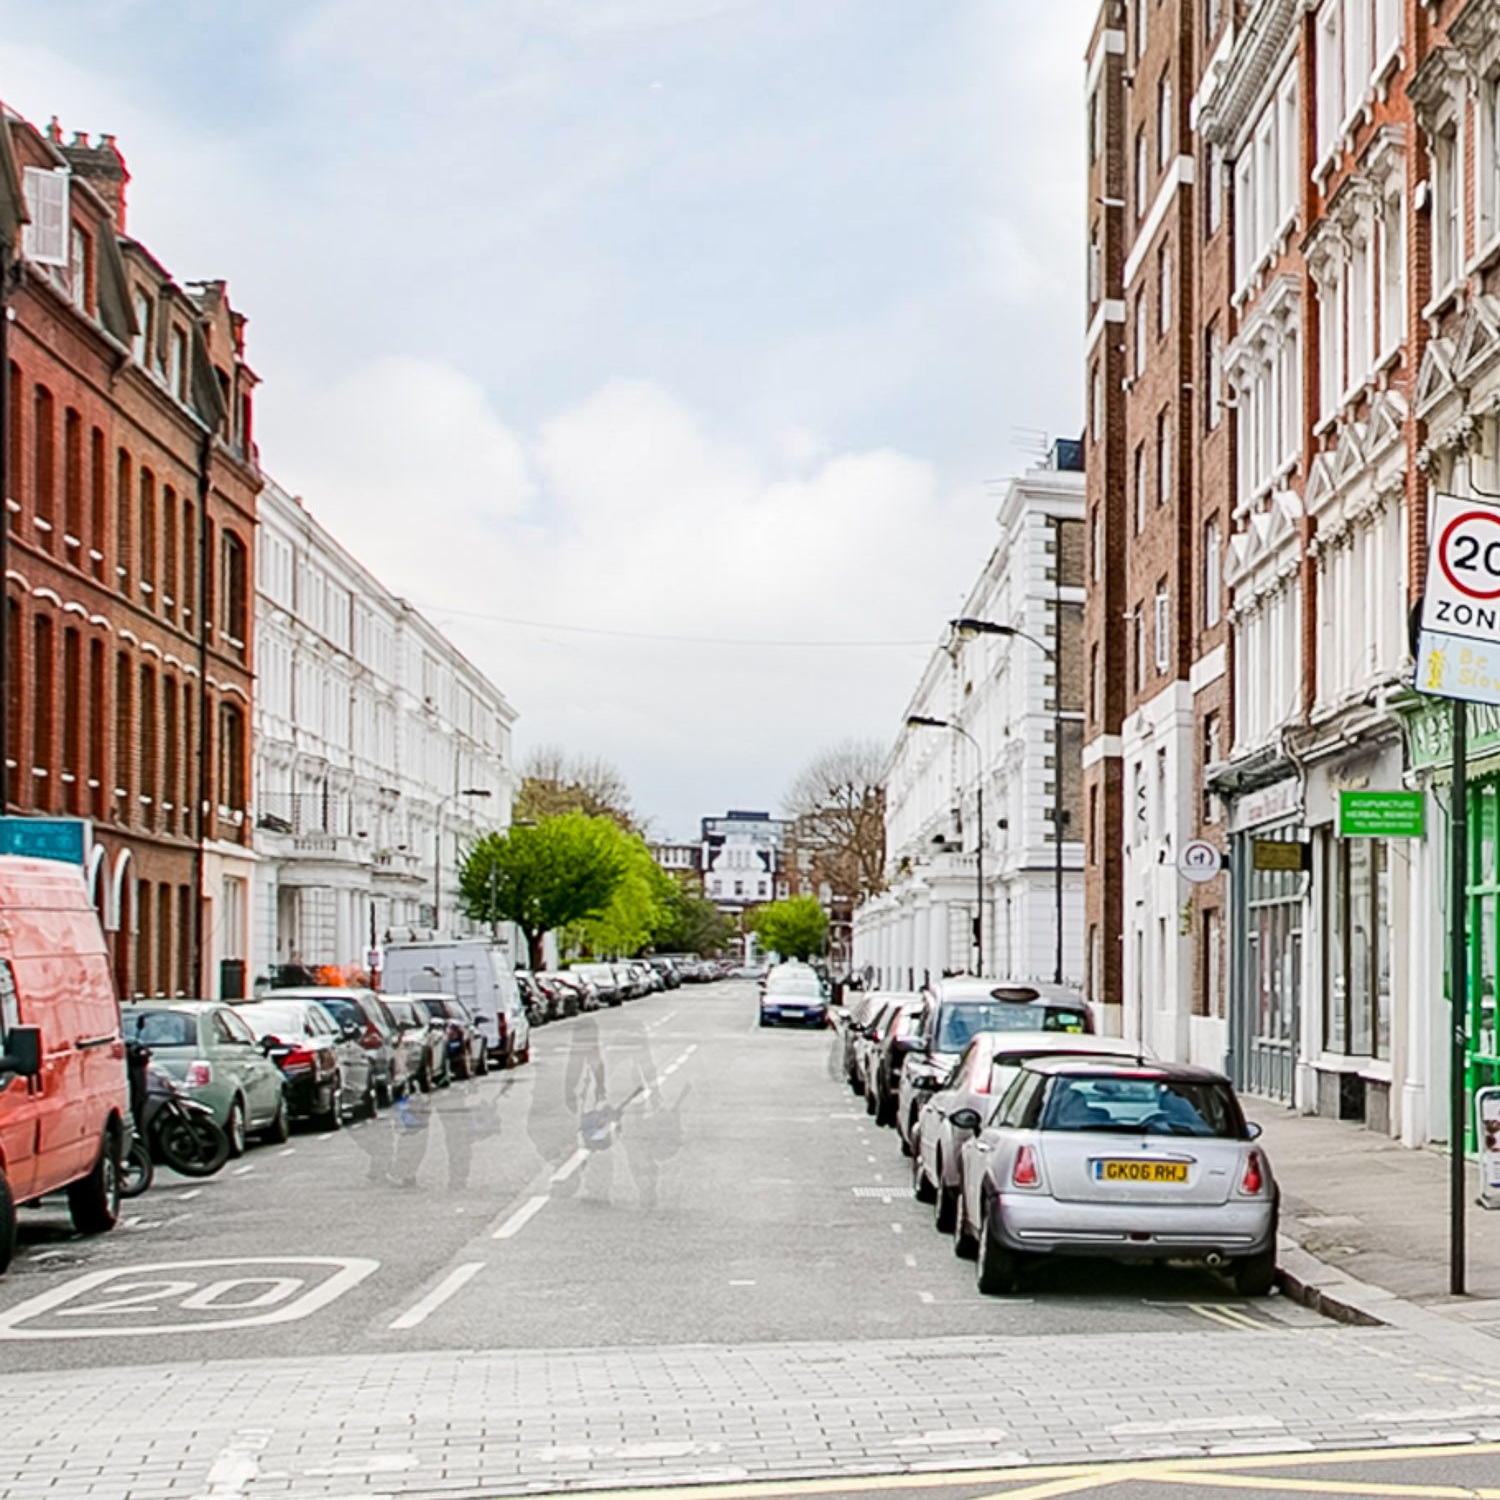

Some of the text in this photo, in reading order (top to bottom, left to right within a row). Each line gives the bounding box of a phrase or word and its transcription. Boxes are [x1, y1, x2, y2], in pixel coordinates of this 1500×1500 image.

[1459, 647, 1490, 671] Be
[1106, 1162, 1188, 1181] GK06 RHJ
[55, 1277, 305, 1316] 20
